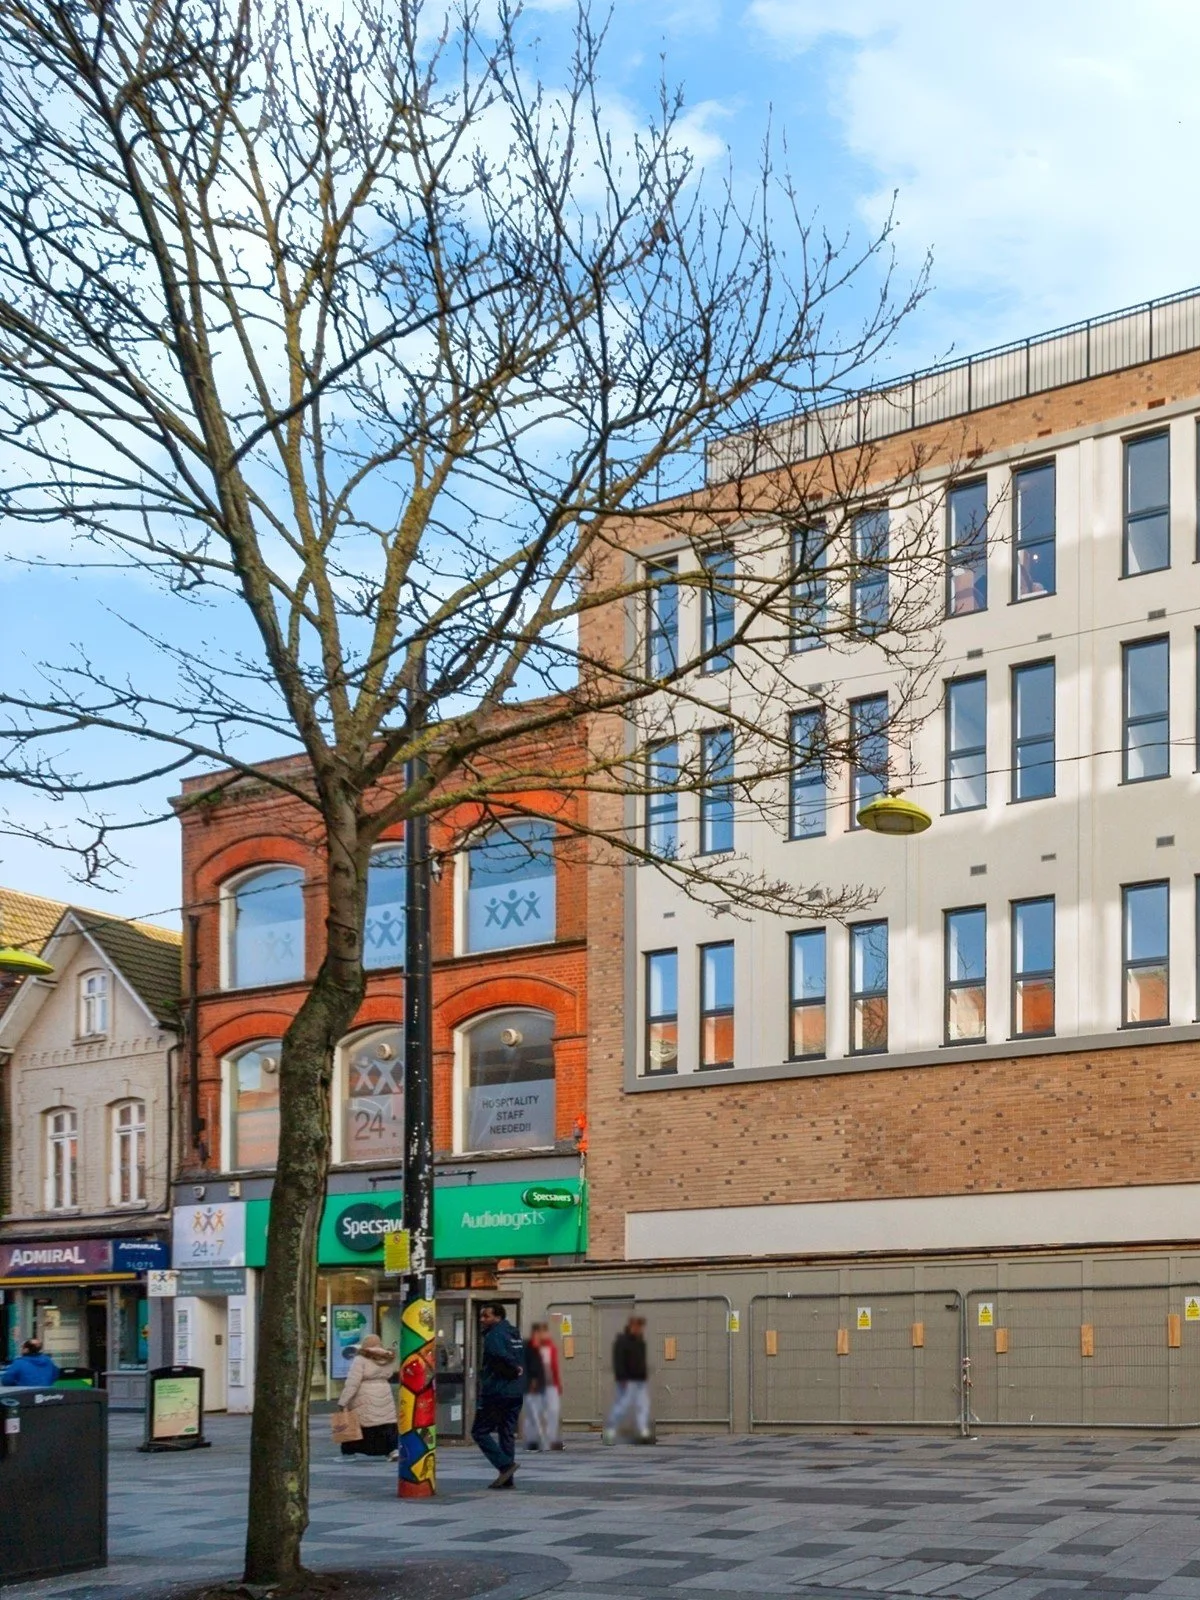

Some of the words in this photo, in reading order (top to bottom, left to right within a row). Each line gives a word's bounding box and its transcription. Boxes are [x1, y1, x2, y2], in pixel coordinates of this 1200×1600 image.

[482, 1095, 539, 1109] HOSPITALITY
[496, 1110, 525, 1121] STAFF
[532, 1192, 571, 1202] Specsavers
[461, 1210, 546, 1230] Audiologists
[119, 1243, 161, 1251] ADMIRAL
[192, 1240, 225, 1257] 24:7
[9, 1246, 87, 1267] ADMIRAL
[126, 1261, 154, 1269] SLOTS
